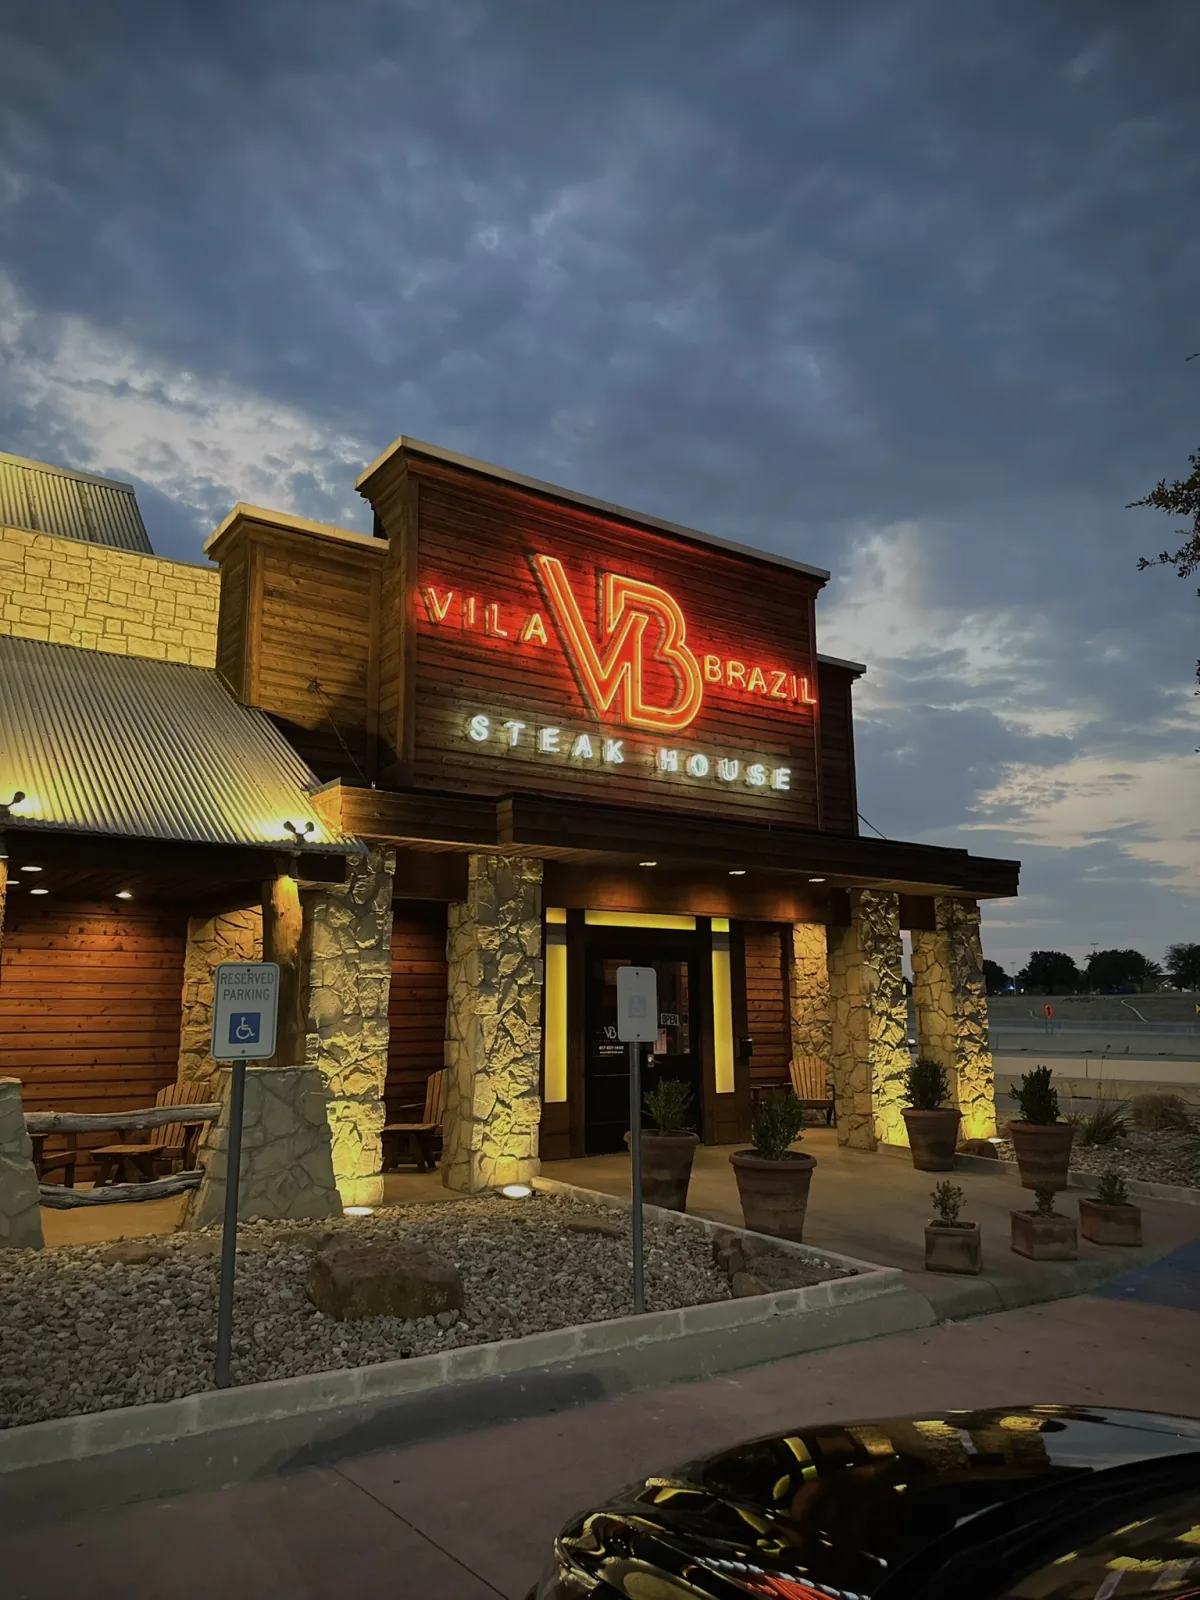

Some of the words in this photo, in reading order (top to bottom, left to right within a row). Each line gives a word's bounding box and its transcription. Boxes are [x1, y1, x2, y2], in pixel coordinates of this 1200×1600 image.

[423, 586, 547, 646] VILA
[533, 553, 704, 731] VB
[702, 654, 818, 705] BRAZIL
[467, 714, 625, 765] STEAK
[656, 748, 792, 791] HOUSE
[220, 972, 274, 985] RESERVED
[223, 988, 270, 1001] PARKING
[662, 1015, 678, 1025] OPEN
